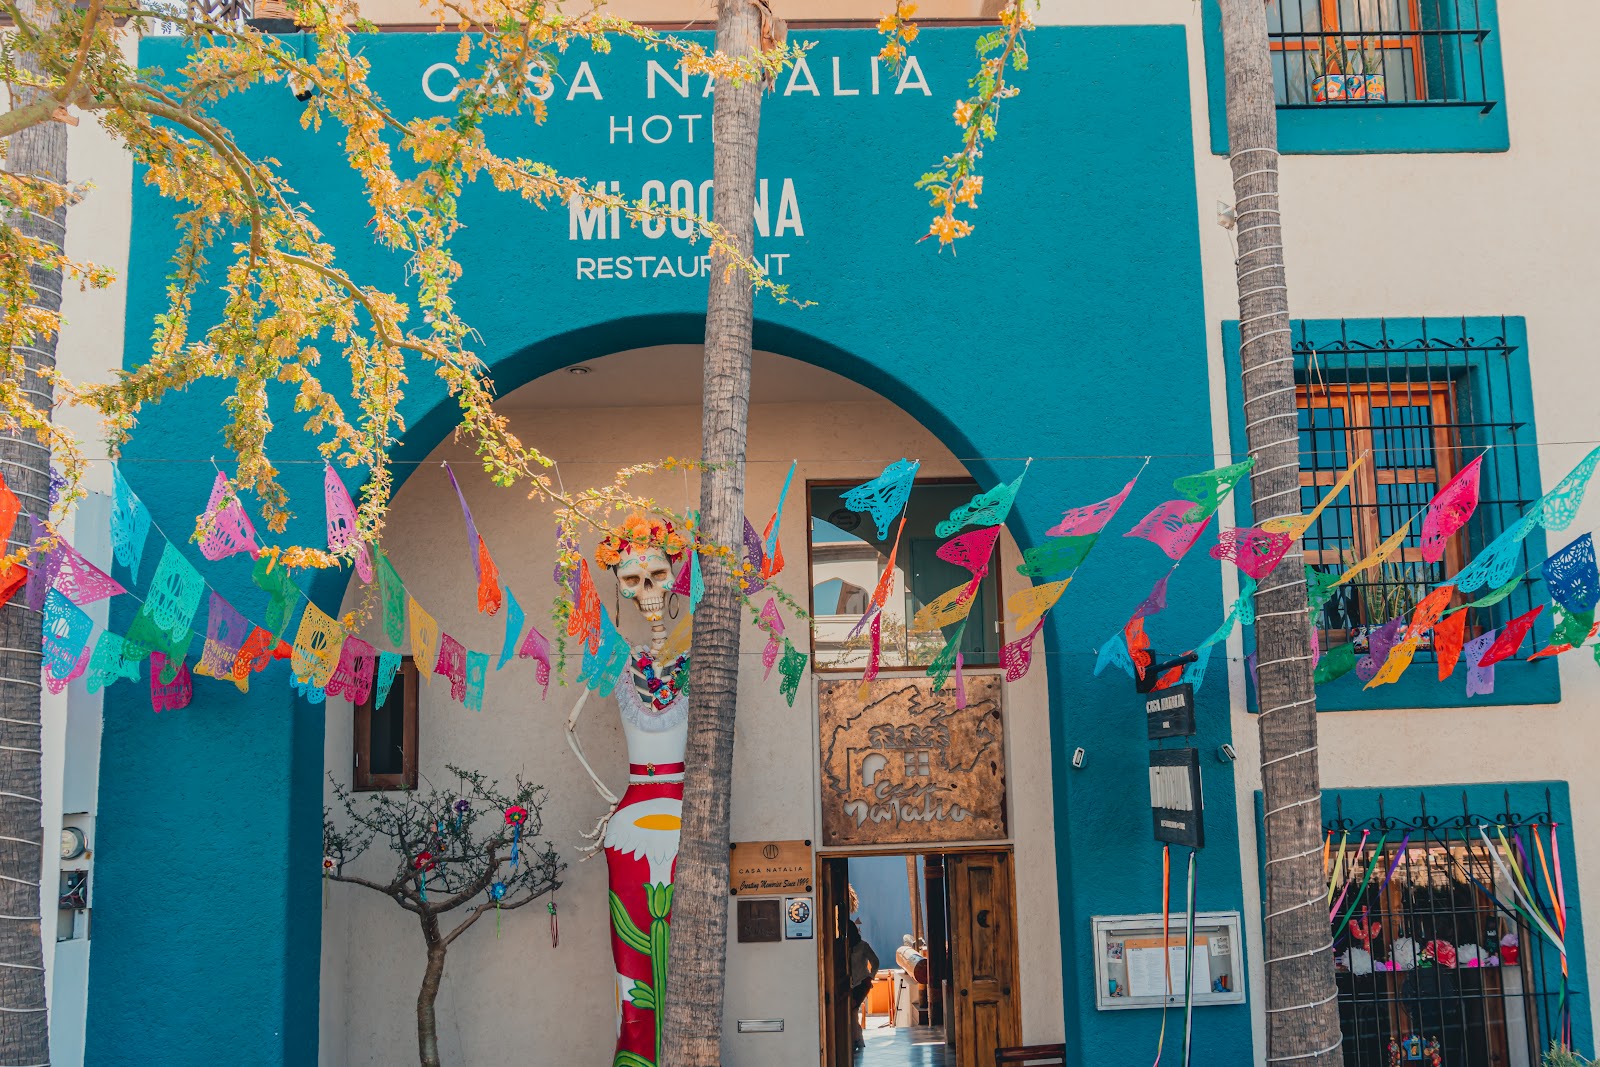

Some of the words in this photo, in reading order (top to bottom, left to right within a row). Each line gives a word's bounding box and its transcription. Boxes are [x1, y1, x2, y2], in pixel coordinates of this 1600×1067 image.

[422, 60, 603, 102] CASA
[647, 55, 932, 98] NALIA
[610, 114, 715, 144] HOT
[641, 178, 804, 239] COCNA
[576, 253, 791, 280] RESTAURNT
[929, 687, 957, 698] HOTE
[739, 867, 761, 875] CASA
[783, 879, 796, 888] Since
